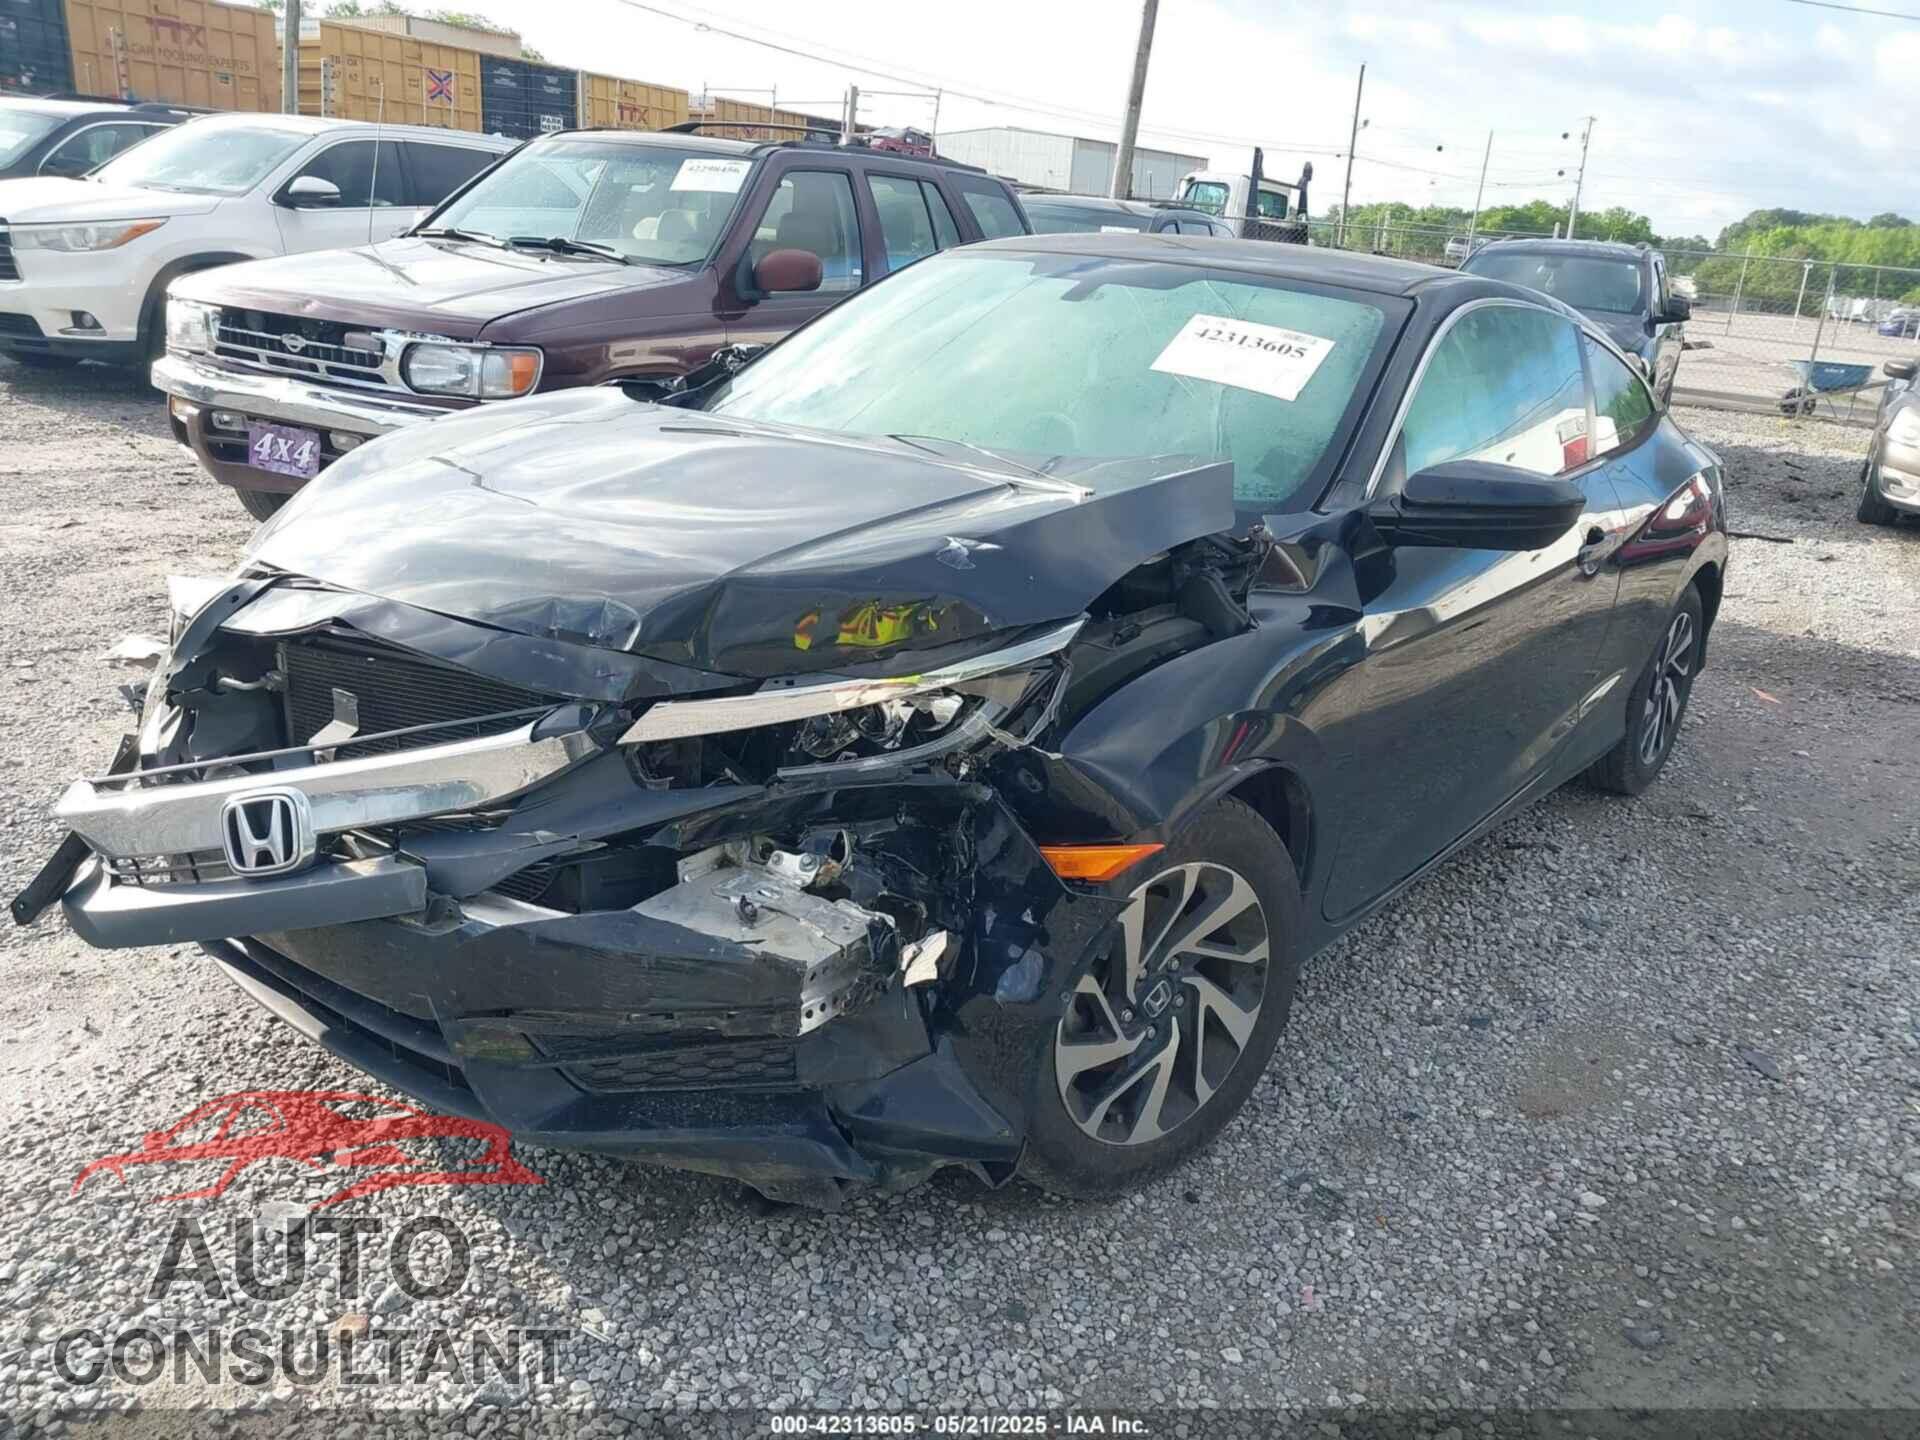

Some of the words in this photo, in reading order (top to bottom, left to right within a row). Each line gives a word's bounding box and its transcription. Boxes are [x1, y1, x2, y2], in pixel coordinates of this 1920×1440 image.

[146, 16, 207, 48] TTX
[617, 104, 649, 125] TTX
[1194, 328, 1308, 359] 42313605
